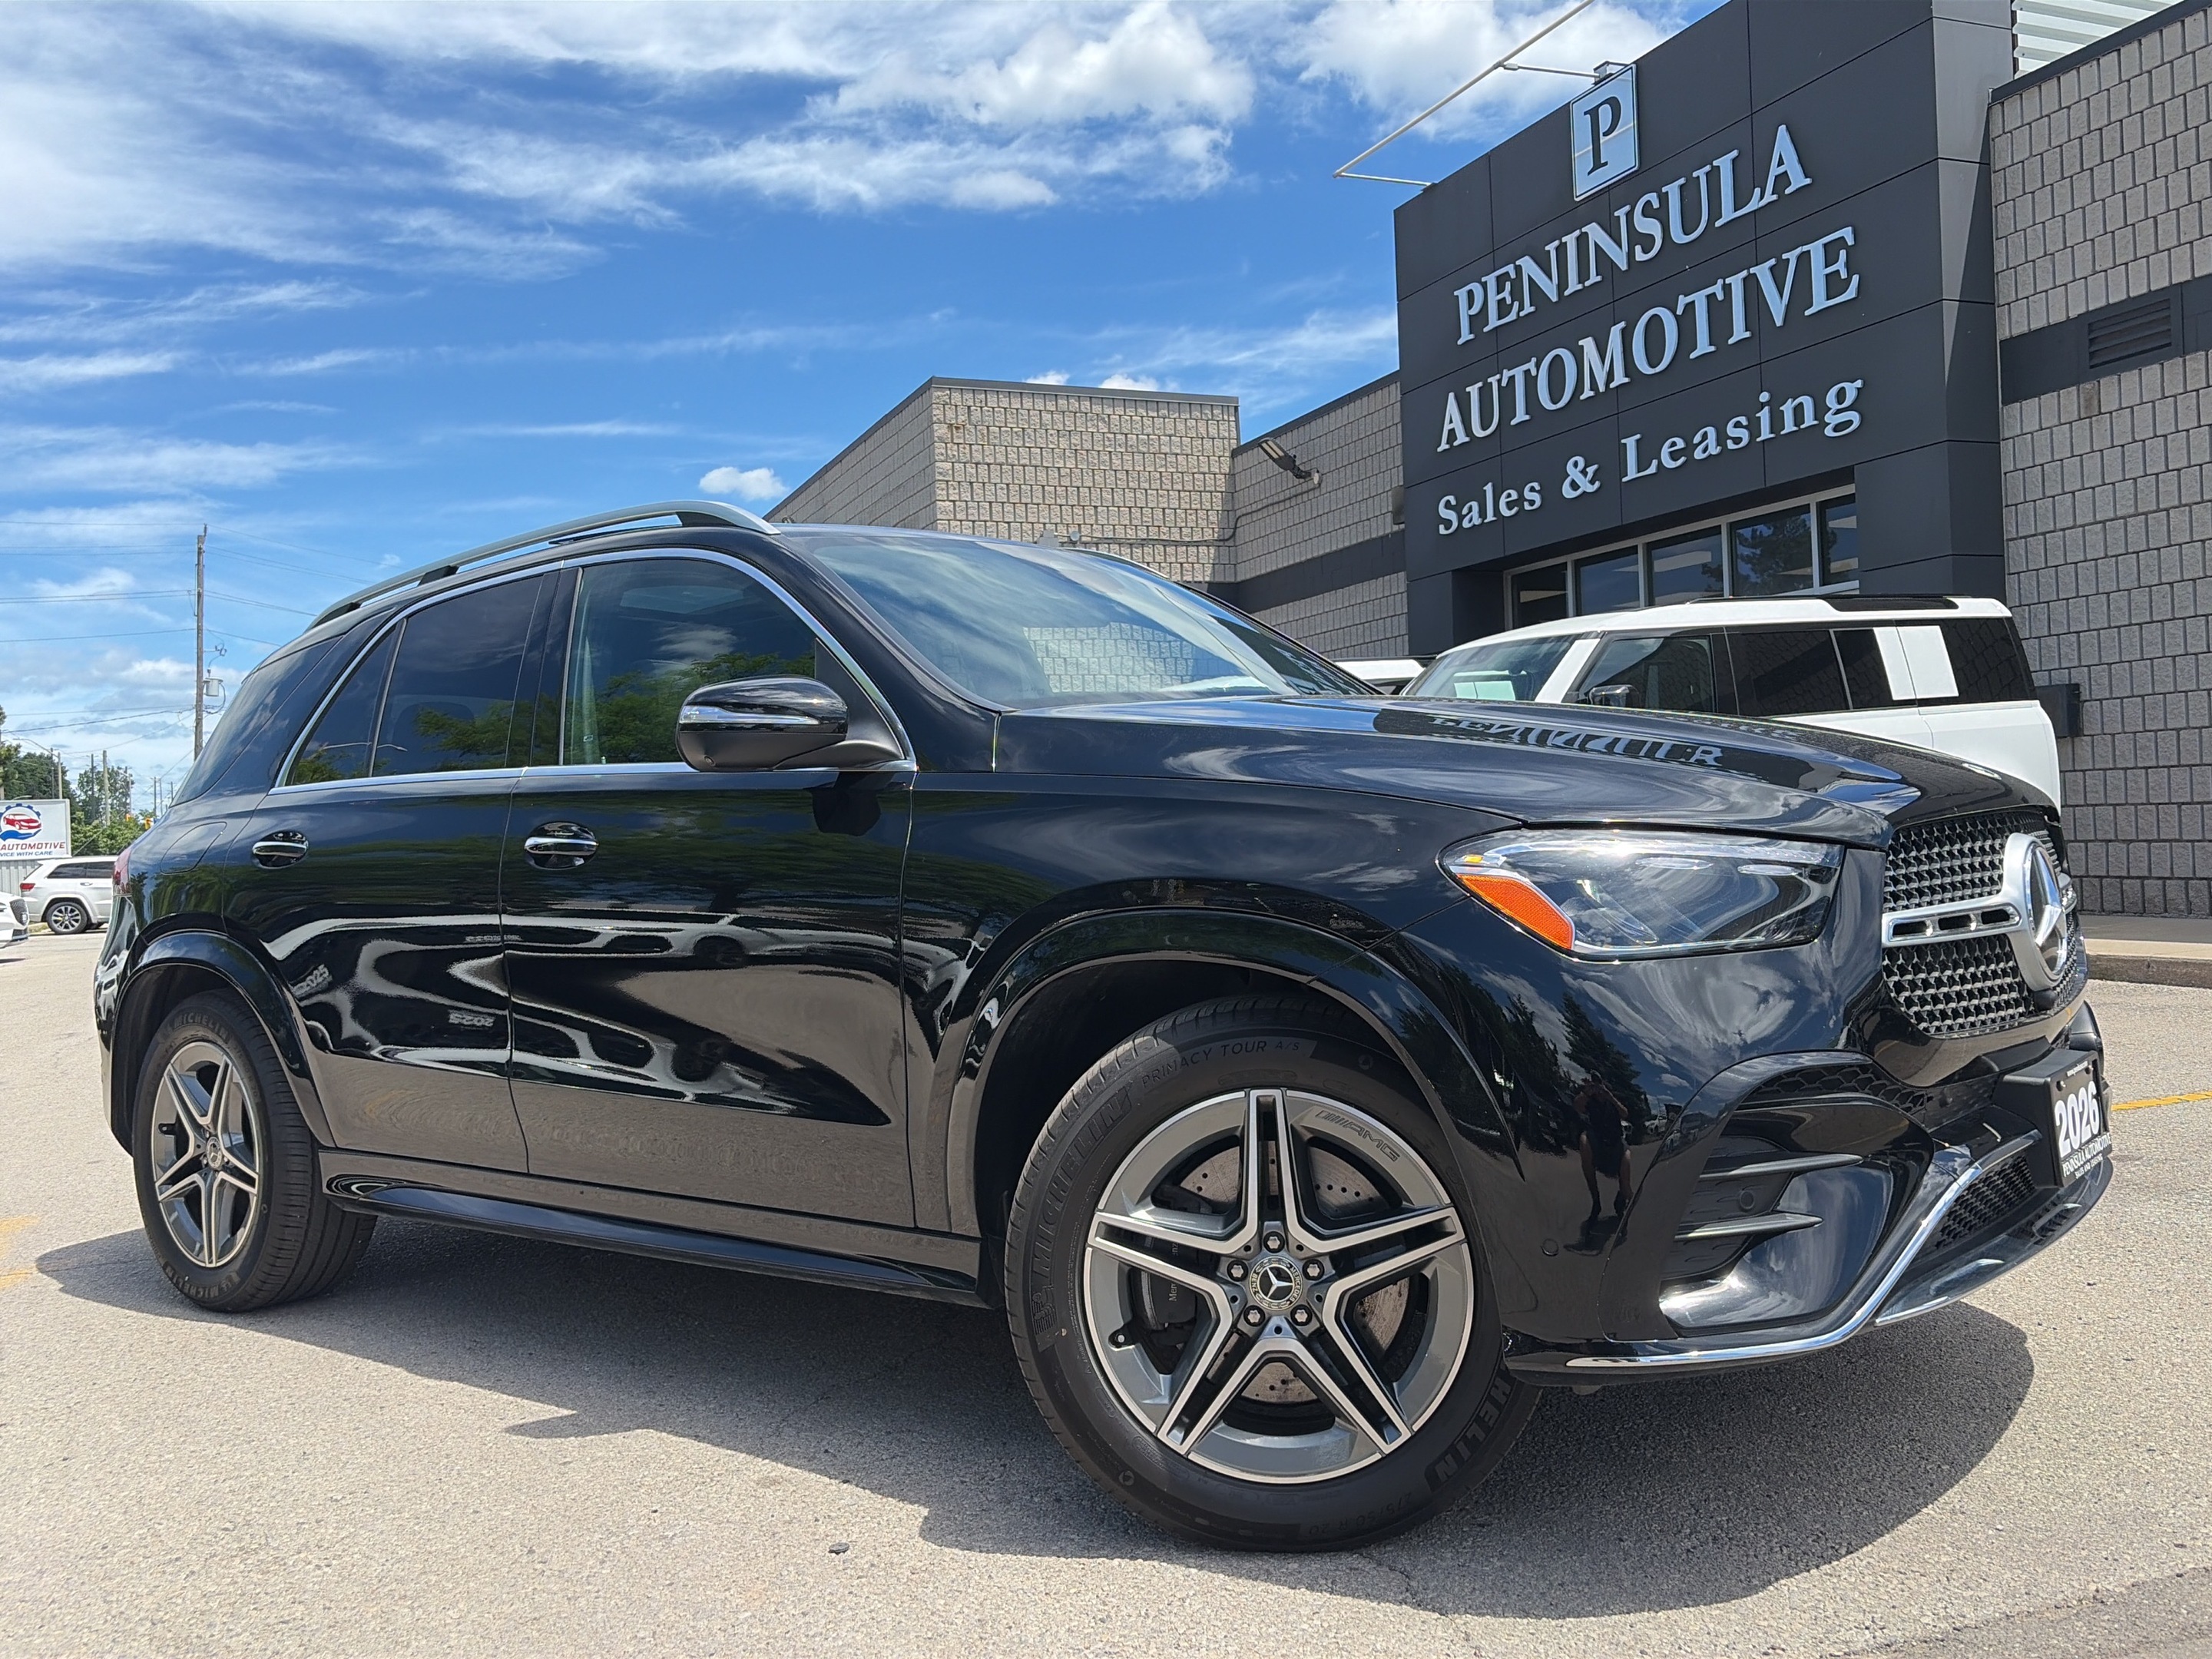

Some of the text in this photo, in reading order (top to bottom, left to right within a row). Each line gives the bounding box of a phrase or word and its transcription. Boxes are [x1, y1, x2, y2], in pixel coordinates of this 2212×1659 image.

[1584, 95, 1622, 176] P
[1454, 124, 1813, 346] PENINSULA
[1437, 226, 1861, 453] AUTOMOTIVE
[1438, 379, 1864, 535] Sales & Leasing
[0, 842, 66, 851] AUTOMOTIVE
[1141, 1048, 1213, 1088] PRIMACY
[1220, 1040, 1267, 1058] TOUR
[1275, 1040, 1300, 1051] A/S
[1343, 1121, 1400, 1162] AMG
[2055, 1081, 2100, 1158] 2026
[1032, 1081, 1131, 1278] MICHELIN
[1289, 1267, 1301, 1303] MERCEDES
